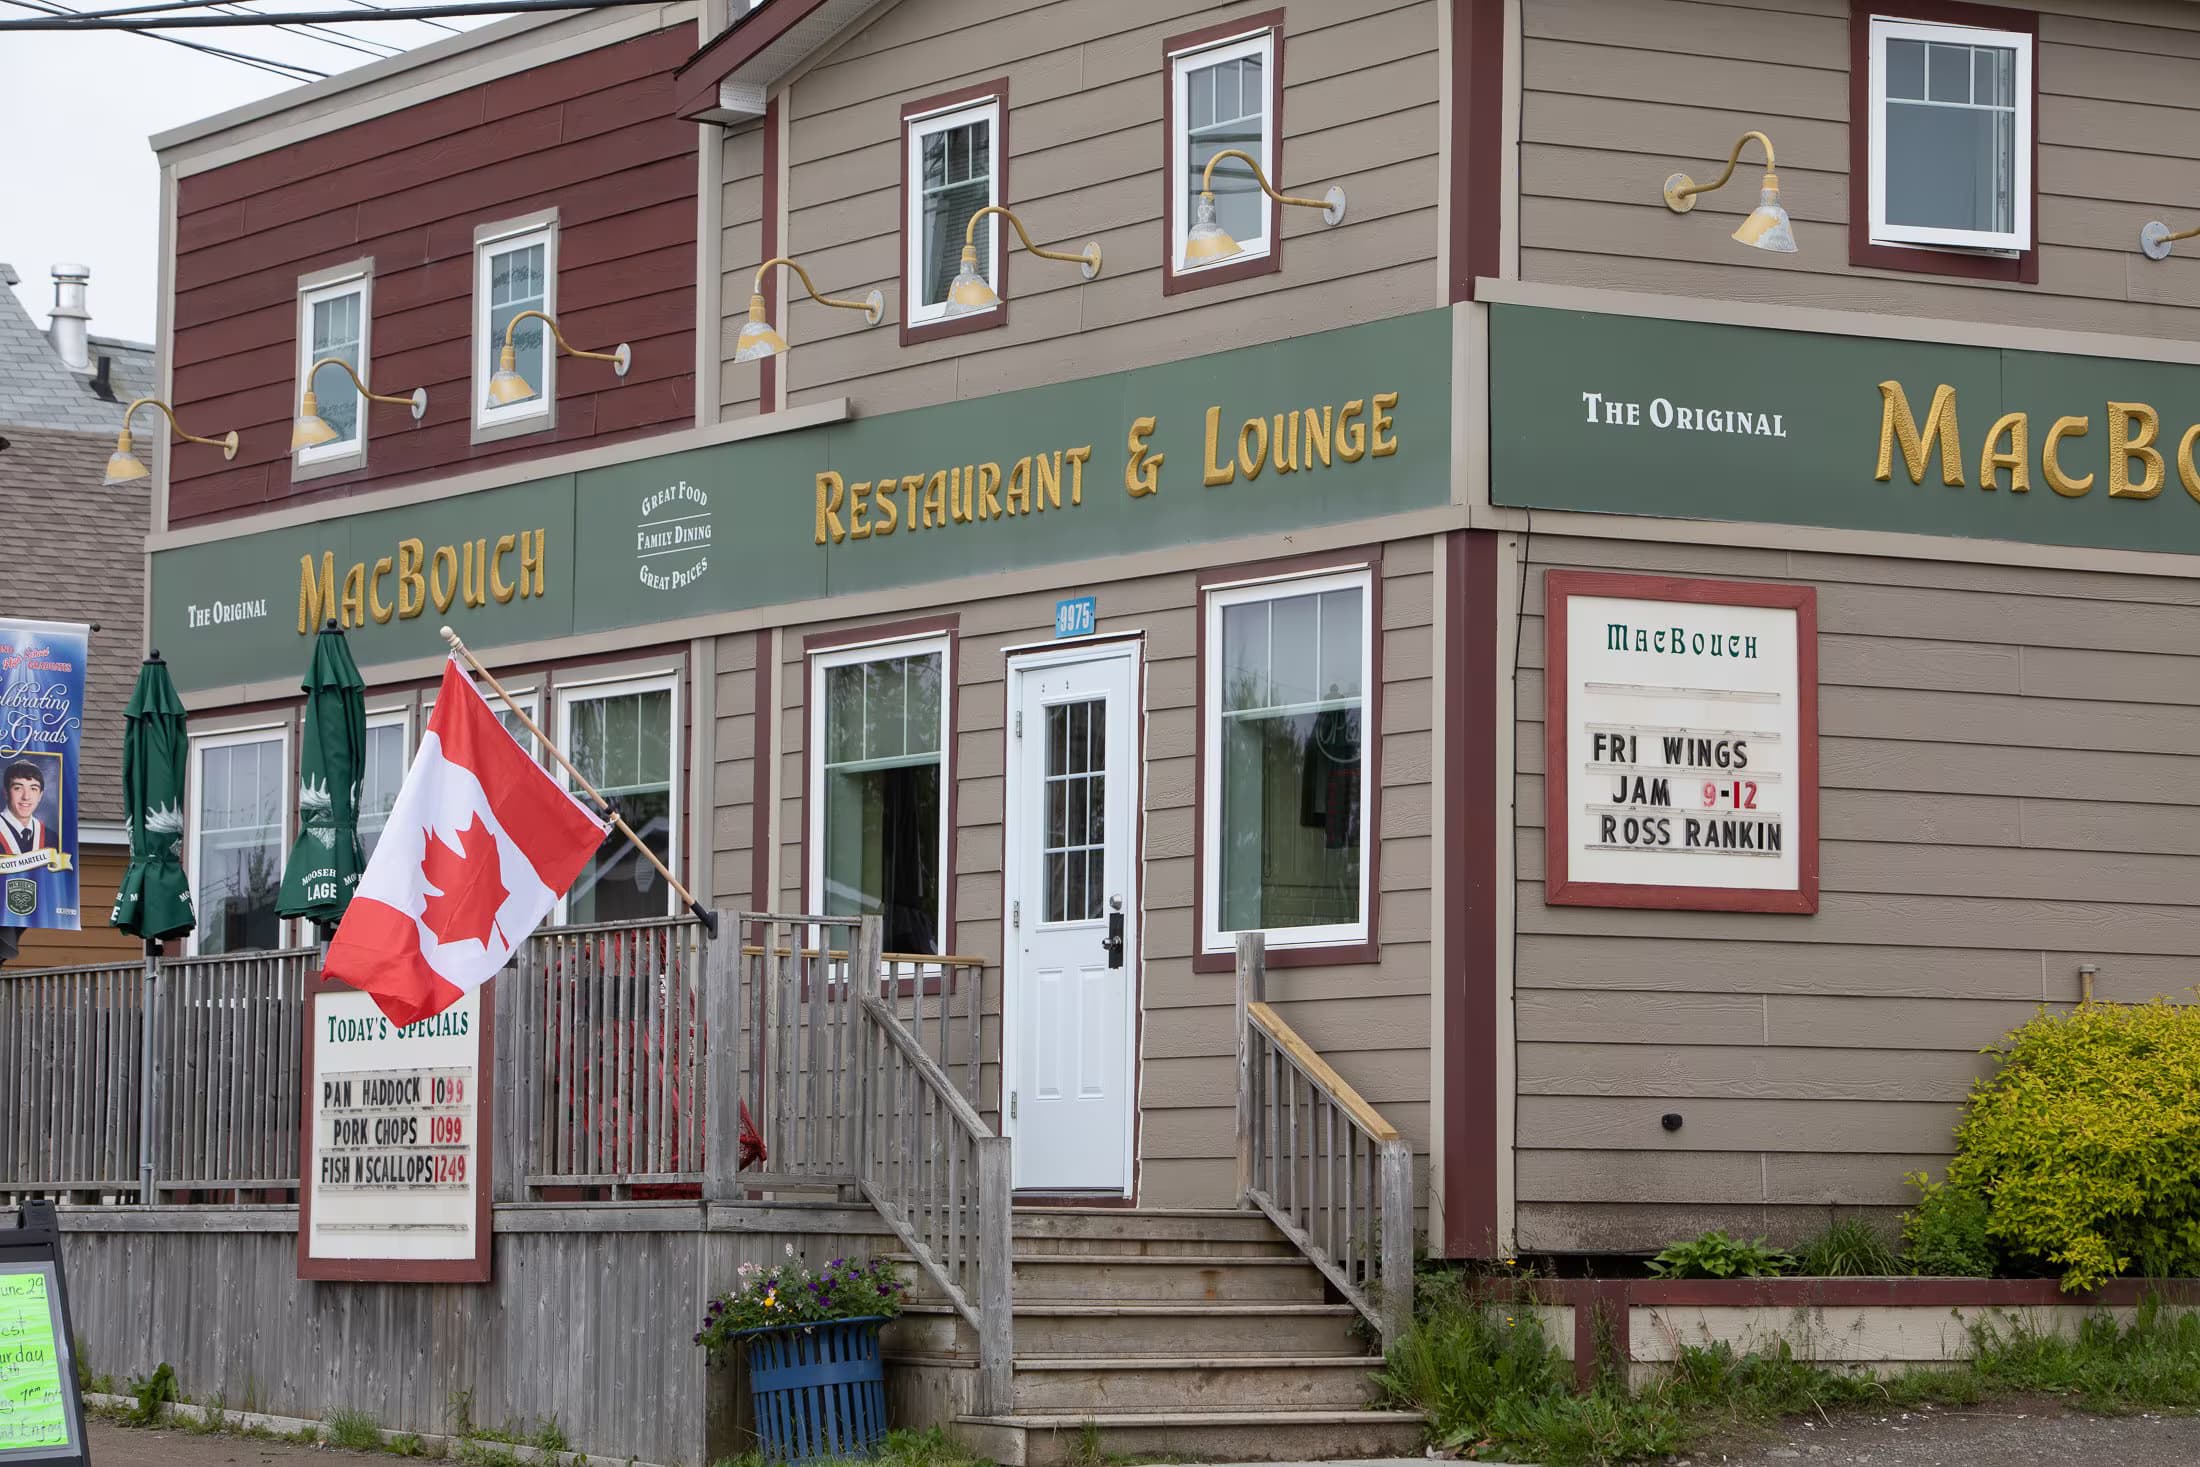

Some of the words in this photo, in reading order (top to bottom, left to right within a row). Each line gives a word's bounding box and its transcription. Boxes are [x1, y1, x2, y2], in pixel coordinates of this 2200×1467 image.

[1582, 391, 1640, 426] THE
[1649, 397, 1787, 437] ORIGINAL
[814, 444, 1091, 545] RESTAURANT
[1124, 416, 1165, 498] &
[1204, 391, 1399, 487] LOUNGE
[641, 486, 676, 516] GREAT
[679, 480, 708, 506] FOOD
[637, 531, 672, 550] FAMILY
[674, 525, 711, 544] DINING
[298, 528, 545, 635] MACBOUCH
[640, 565, 670, 590] GREAT
[672, 557, 708, 589] PRICES
[188, 604, 211, 628] THE
[213, 600, 267, 624] ORIGINAL
[1060, 602, 1090, 633] 9975
[1593, 733, 1637, 763] FRI
[1663, 736, 1748, 769] WINGS
[1612, 775, 1671, 807] JAM
[1703, 780, 1758, 809] 9-12
[1601, 815, 1670, 845] ROSS
[1685, 818, 1782, 851] RANKIN
[19, 853, 47, 866] MARTELL
[328, 1015, 387, 1043] TODAY'S
[323, 1081, 351, 1108] PAN
[362, 1077, 421, 1106] HADDOCK
[334, 1117, 368, 1146] PORK
[375, 1116, 417, 1145] CHOPS
[431, 1116, 462, 1145] 1099
[321, 1156, 350, 1184] FISH
